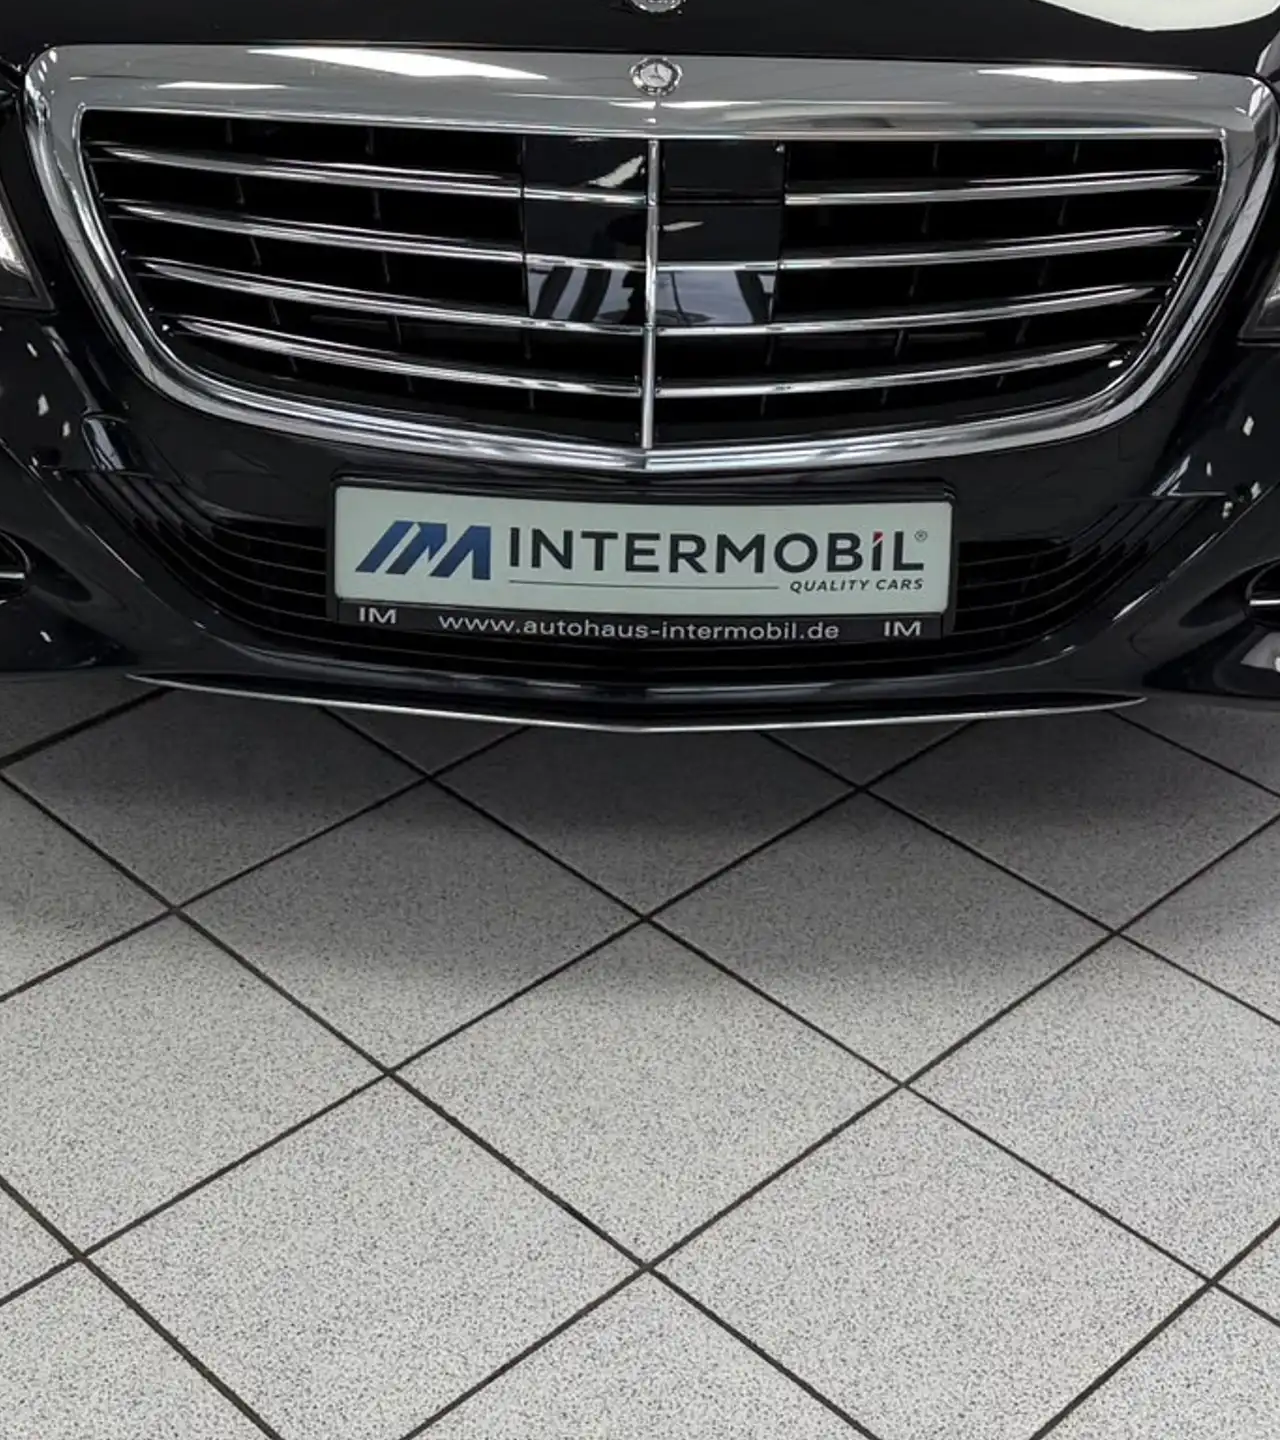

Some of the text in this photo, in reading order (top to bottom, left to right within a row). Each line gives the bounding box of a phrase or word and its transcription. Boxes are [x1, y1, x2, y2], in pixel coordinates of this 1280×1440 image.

[789, 578, 923, 593] QUALITY CARS
[359, 607, 921, 640] IM www.autohaus-intermobil.de IM
